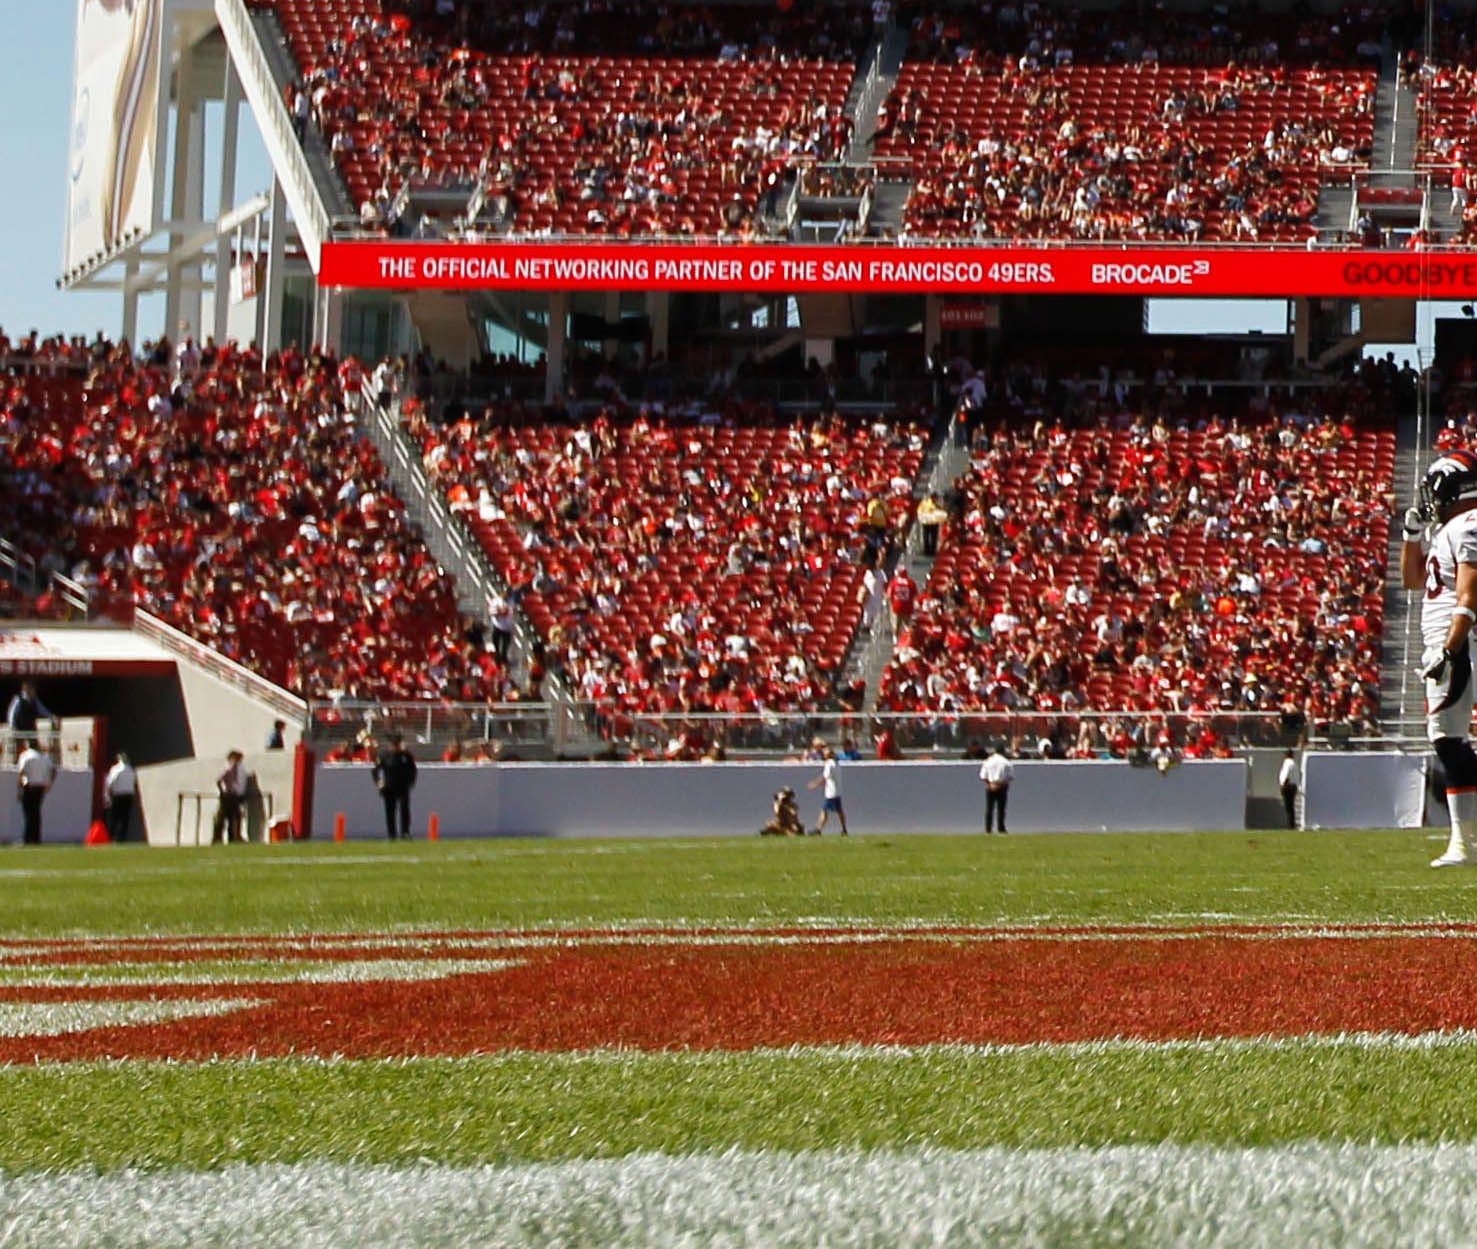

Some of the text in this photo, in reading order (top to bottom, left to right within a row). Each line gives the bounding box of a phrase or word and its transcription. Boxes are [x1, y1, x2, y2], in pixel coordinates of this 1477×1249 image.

[378, 256, 1057, 284] THE OFFICIAL NETWORKING PARTNER OF THE SAN FRANCISCO 49ERS.
[1091, 263, 1193, 285] BROCADE
[1342, 262, 1477, 287] GOODBYE
